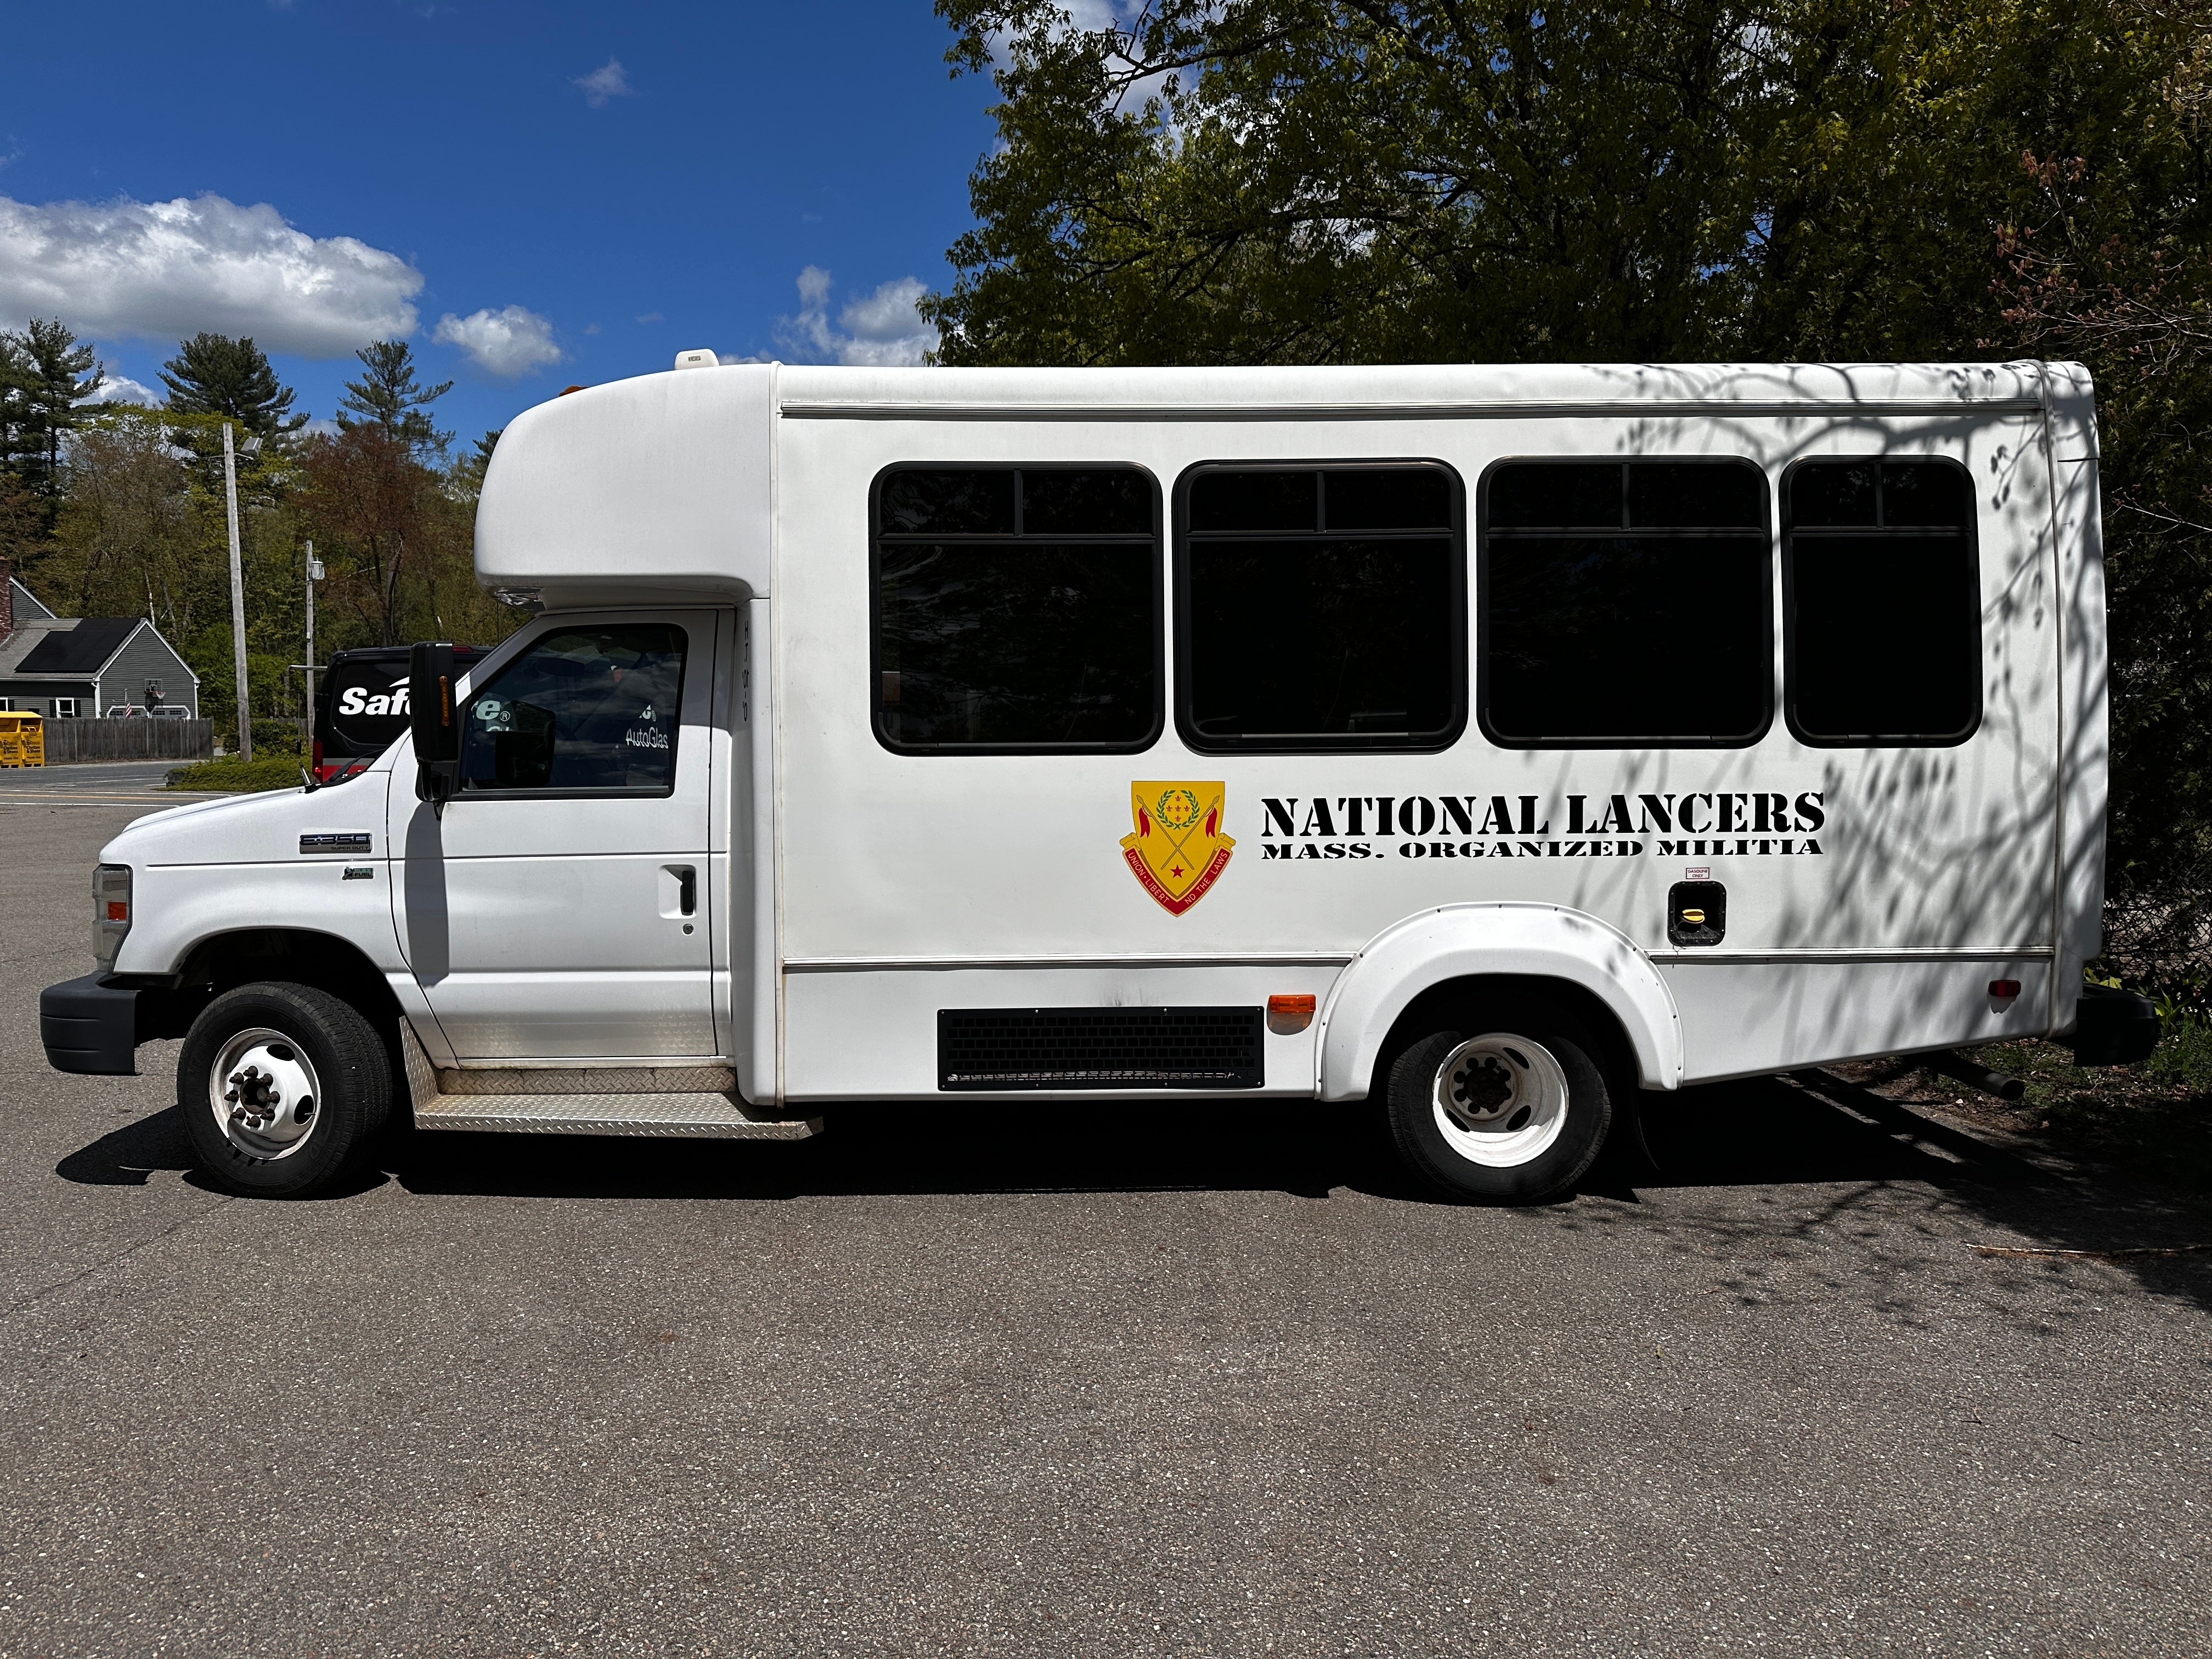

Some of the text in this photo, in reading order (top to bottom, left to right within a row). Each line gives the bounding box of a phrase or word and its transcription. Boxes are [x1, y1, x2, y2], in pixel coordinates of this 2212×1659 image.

[339, 687, 410, 715] Saf
[1261, 792, 1825, 837] NATIONAL LANCERS
[1261, 839, 1824, 860] MASS. ORGANIZED MILITIA
[1128, 852, 1146, 876] UNION
[1196, 877, 1211, 891] THE
[1210, 852, 1228, 874] LAWS
